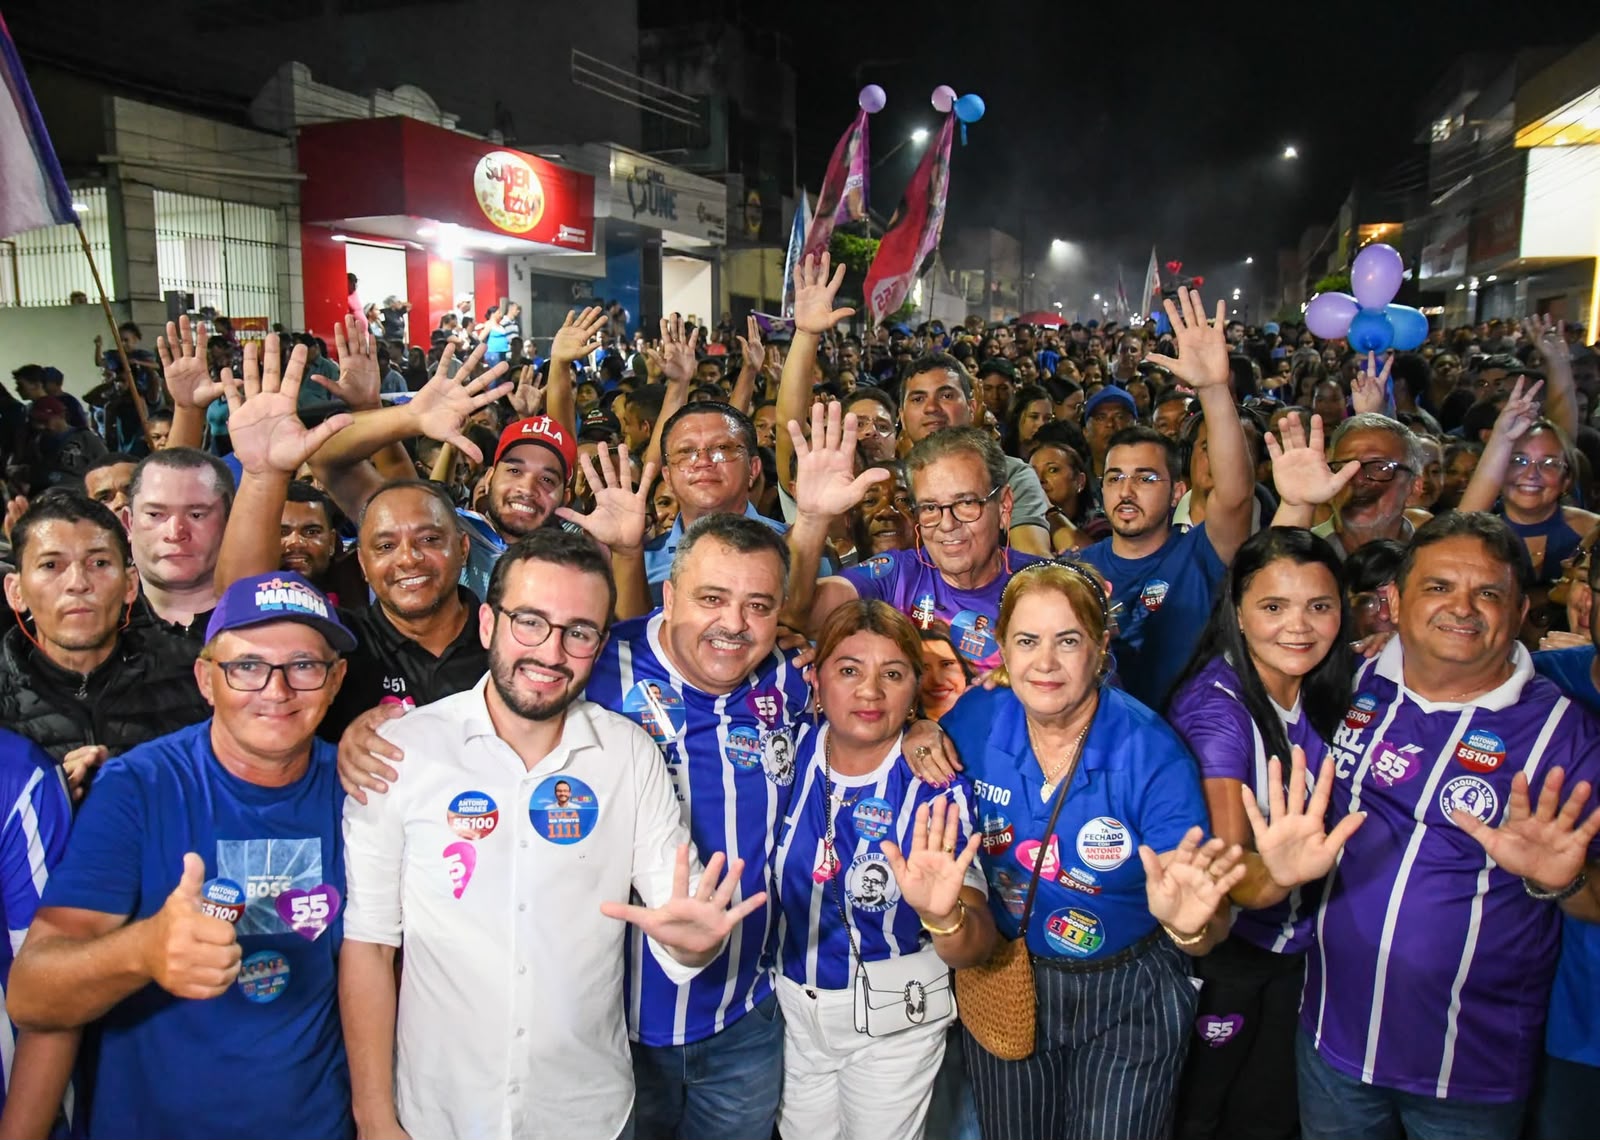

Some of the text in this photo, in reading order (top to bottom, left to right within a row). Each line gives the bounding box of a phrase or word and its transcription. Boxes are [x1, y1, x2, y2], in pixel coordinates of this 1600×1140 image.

[521, 420, 563, 445] LULA
[255, 588, 329, 618] MAINHA
[959, 640, 984, 657] 1111
[754, 695, 778, 717] 55
[1468, 740, 1495, 752] MORAES
[1469, 735, 1499, 747] ANTONIO
[1375, 749, 1410, 779] 55
[1457, 747, 1498, 767] 55100
[973, 779, 1011, 806] 55100
[1448, 779, 1494, 809] RAQUEL LYRA
[458, 805, 488, 813] MORAES
[548, 810, 580, 819] LULA
[453, 816, 495, 831] 55100
[548, 822, 581, 839] 1111
[983, 831, 1012, 847] 55100
[1084, 832, 1124, 841] FECHADO
[1085, 846, 1122, 854] ANTONIO
[209, 884, 240, 897] ANTONIO
[1060, 874, 1096, 894] 55100
[291, 893, 330, 922] 55
[1062, 915, 1090, 932] AGORA
[1205, 1020, 1235, 1038] 55
